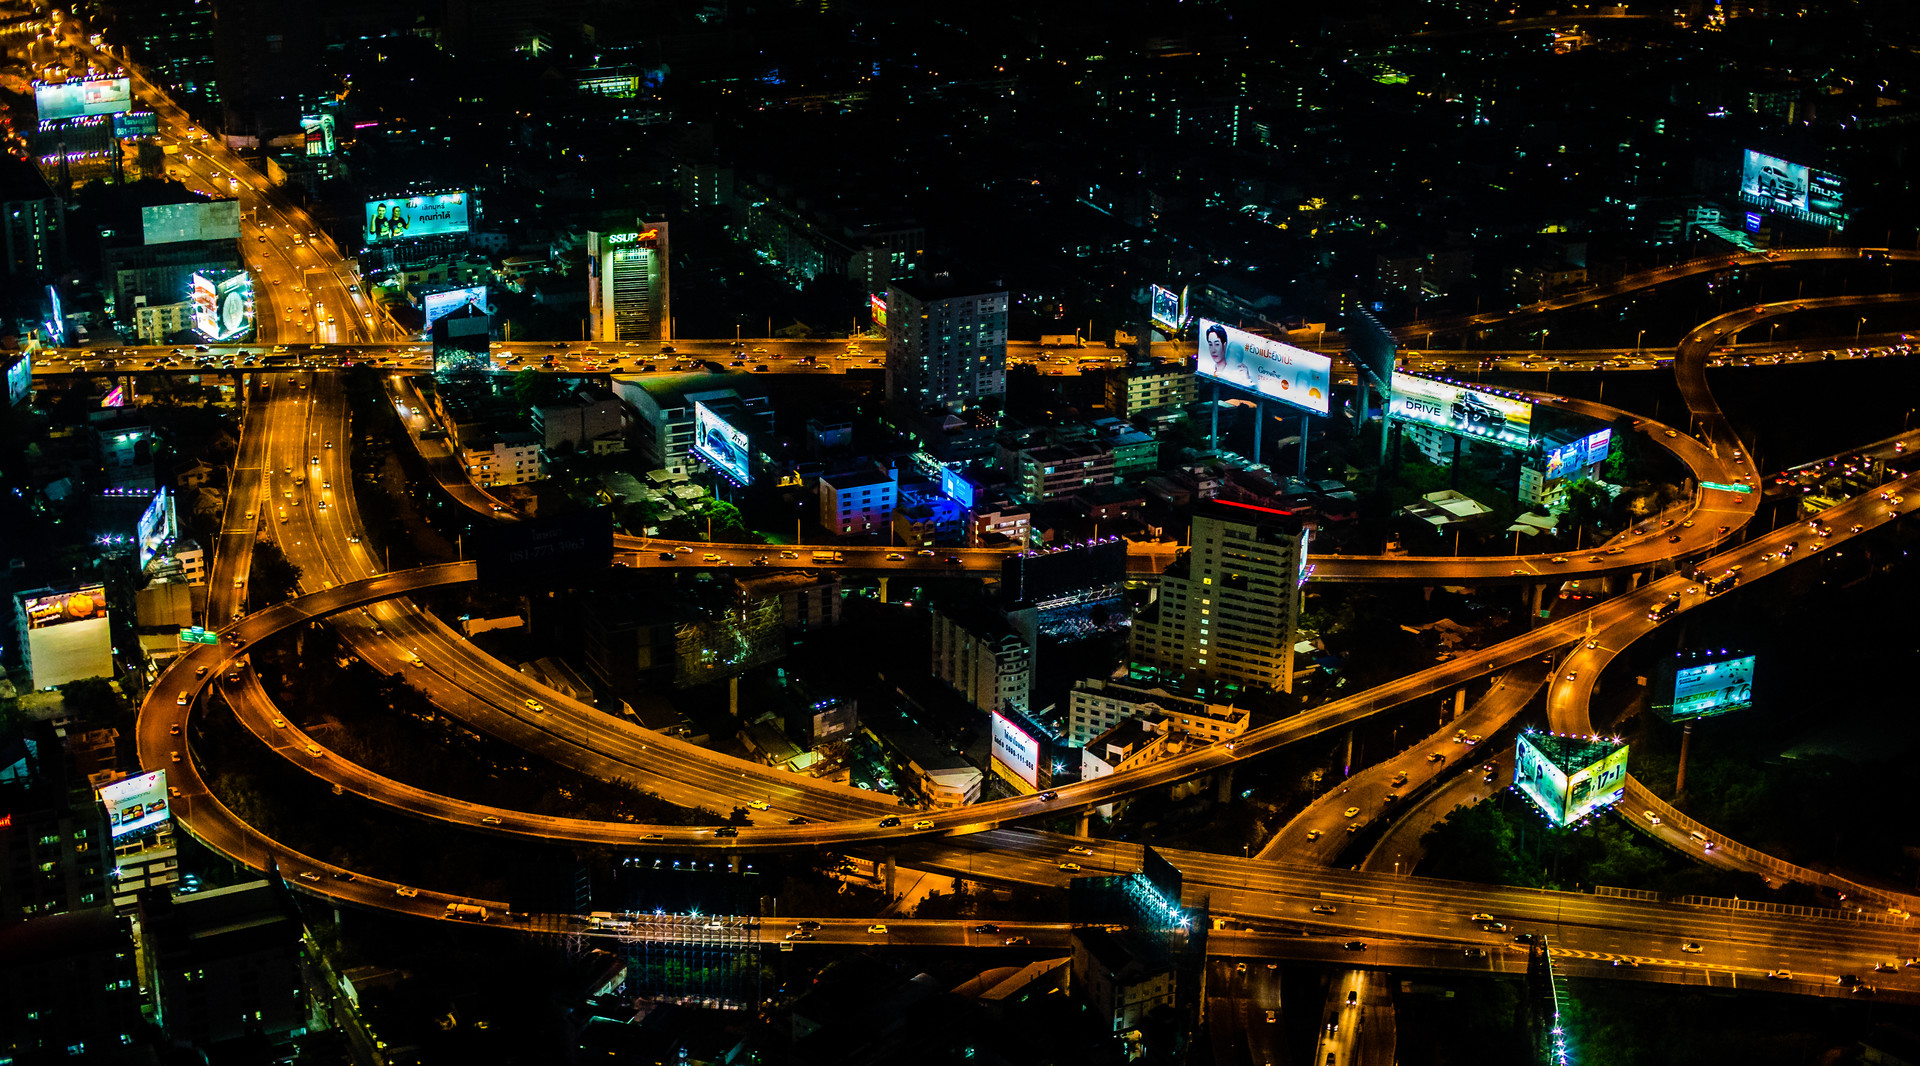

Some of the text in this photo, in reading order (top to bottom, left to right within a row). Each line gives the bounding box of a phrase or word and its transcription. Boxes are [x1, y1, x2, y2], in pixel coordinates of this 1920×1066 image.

[420, 211, 451, 224] คุณทำได้
[609, 233, 638, 243] SSUP
[1405, 401, 1441, 416] DRIVE
